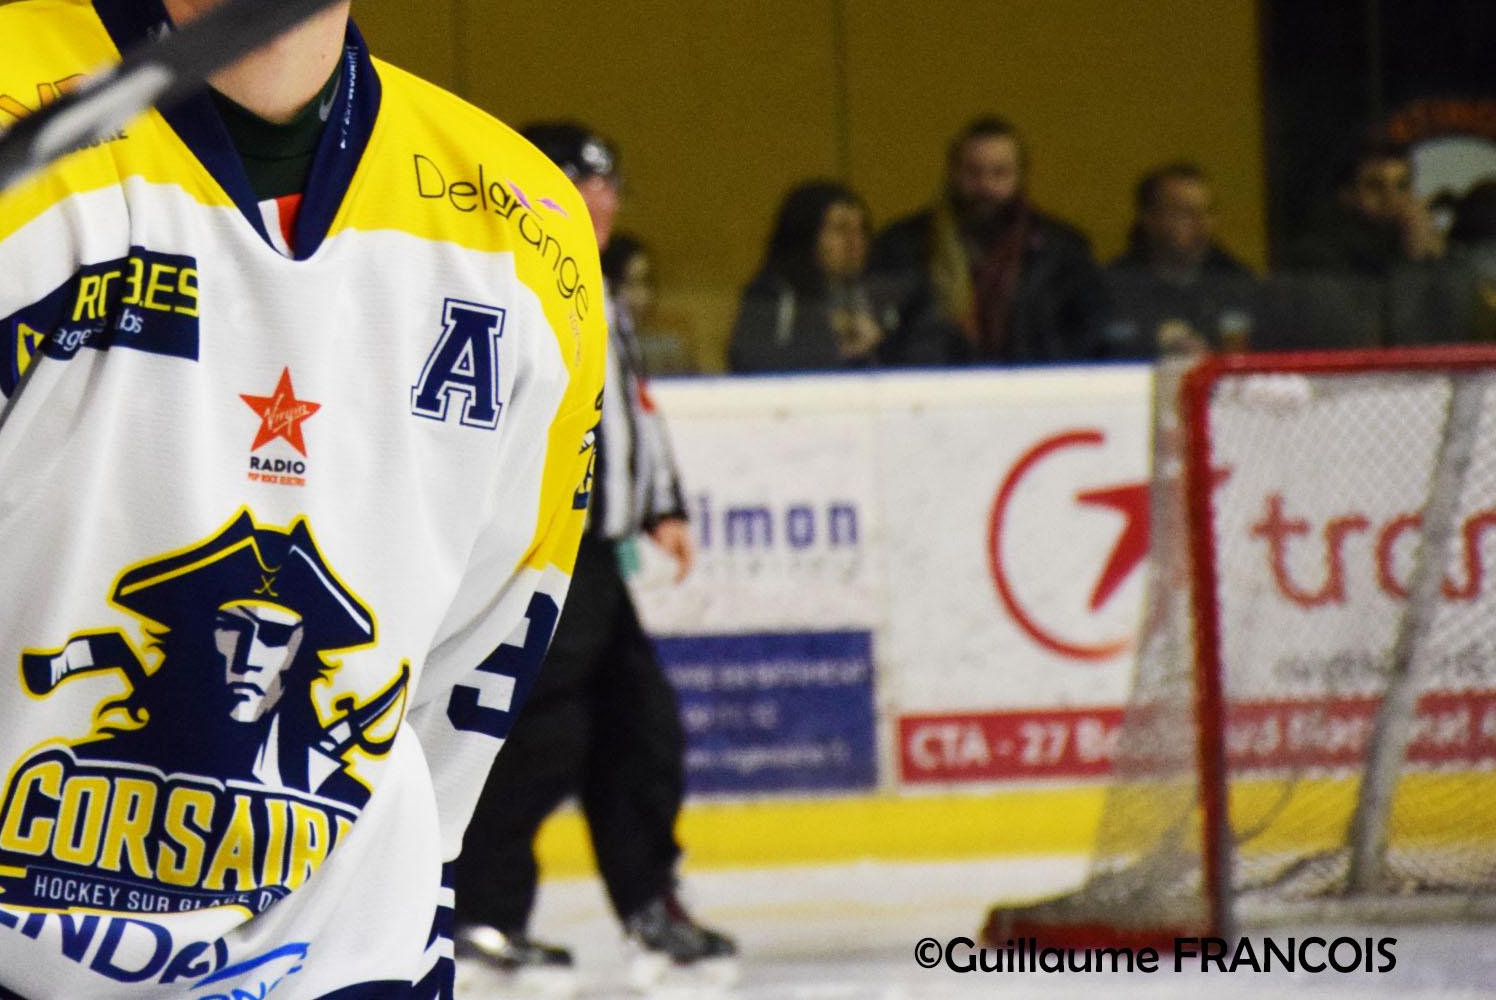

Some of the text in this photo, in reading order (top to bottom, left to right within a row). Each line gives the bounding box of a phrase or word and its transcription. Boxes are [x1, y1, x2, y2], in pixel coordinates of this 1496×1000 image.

[411, 297, 506, 431] A
[250, 456, 306, 475] RADIO
[33, 874, 121, 908] HOCKEY
[127, 890, 171, 913] SUR
